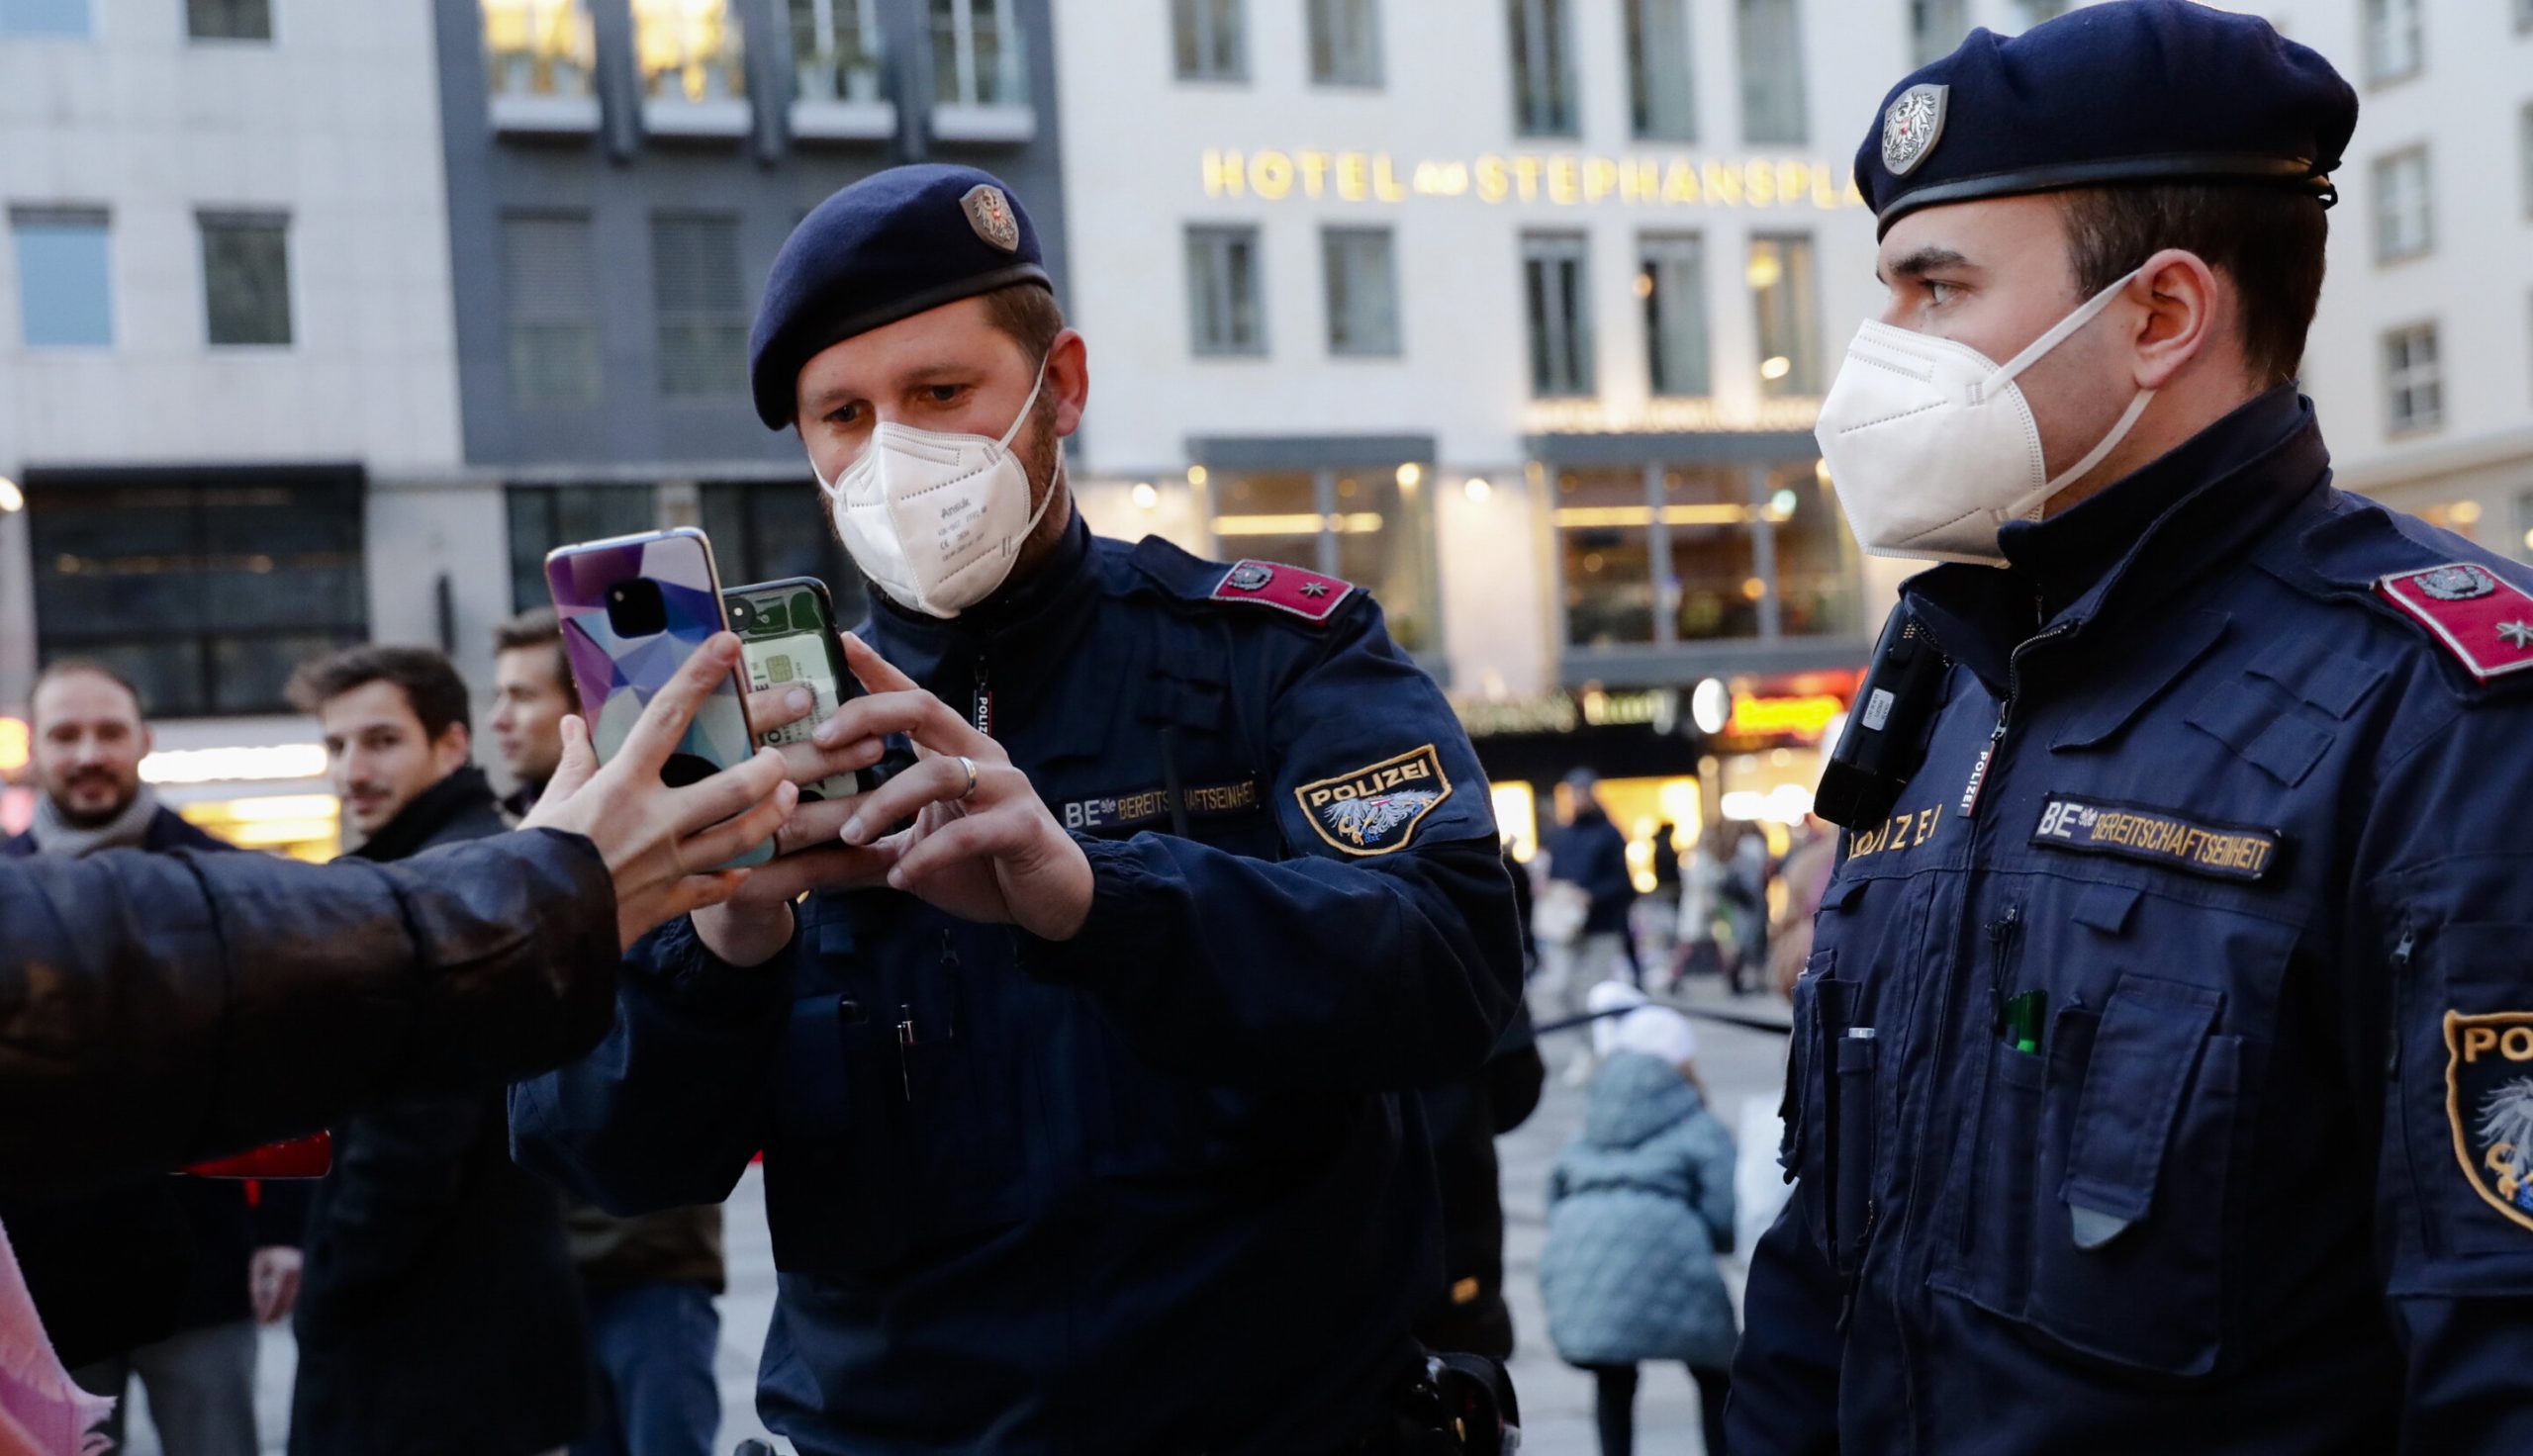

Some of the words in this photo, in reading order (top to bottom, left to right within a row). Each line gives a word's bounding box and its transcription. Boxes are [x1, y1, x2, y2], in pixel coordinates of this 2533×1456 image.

[1201, 146, 1406, 203] HOTEL
[978, 696, 988, 734] POLIZ
[1065, 799, 1102, 829] BE
[1117, 780, 1254, 821] BEREITSAFTSEINHE
[1310, 759, 1431, 808] POLIZEI
[1961, 751, 1989, 807] POLIZEI
[2036, 801, 2082, 839] BE
[2091, 812, 2271, 871] BEREITSCHAFTSEINHEIT
